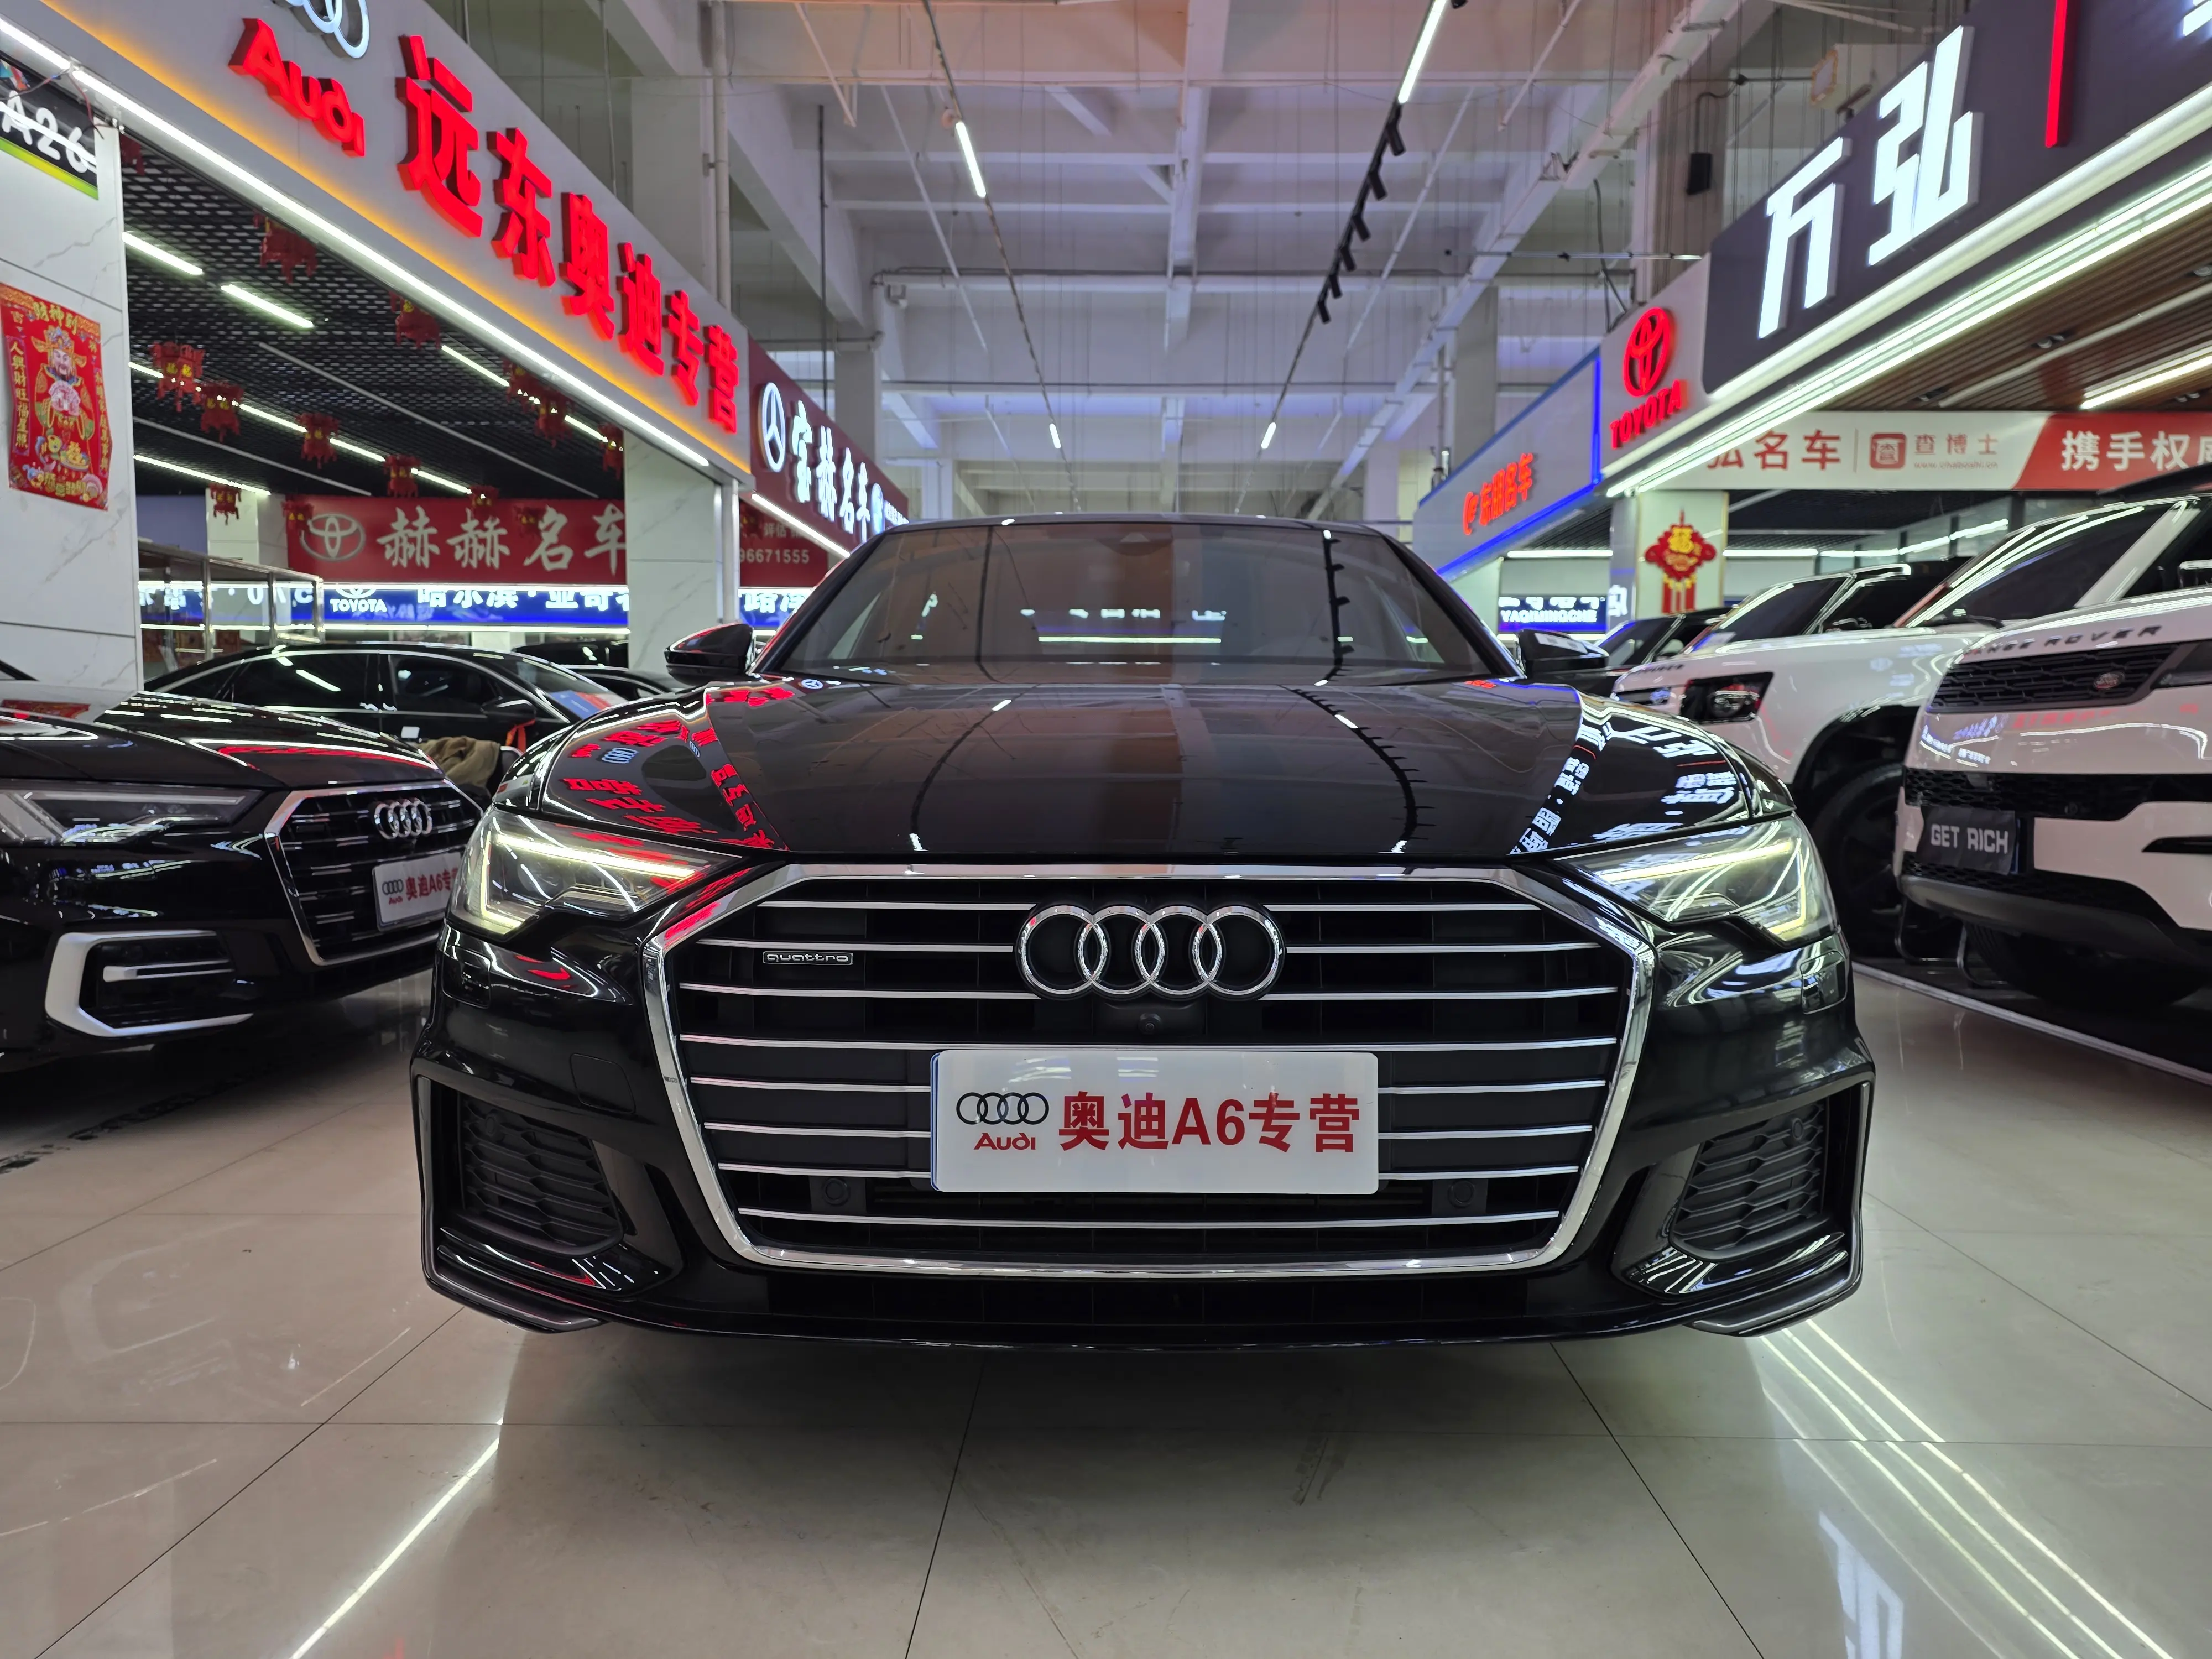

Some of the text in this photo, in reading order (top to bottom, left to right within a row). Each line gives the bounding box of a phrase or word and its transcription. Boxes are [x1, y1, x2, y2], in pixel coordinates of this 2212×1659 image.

[228, 18, 366, 157] Audi
[2, 90, 97, 173] A26
[1758, 25, 1984, 338] 万弘
[396, 35, 739, 434] 远东奥迪专营
[1610, 379, 1684, 449] TOYOTA
[376, 504, 625, 576] 赫赫名车
[330, 599, 388, 612] TOYOTA
[2044, 625, 2162, 646] ROVER
[1931, 823, 2008, 854] GET RICH
[766, 953, 848, 963] quattro
[973, 1132, 1036, 1151] Audi
[1058, 1091, 1360, 1153] 奥迪A6专营
